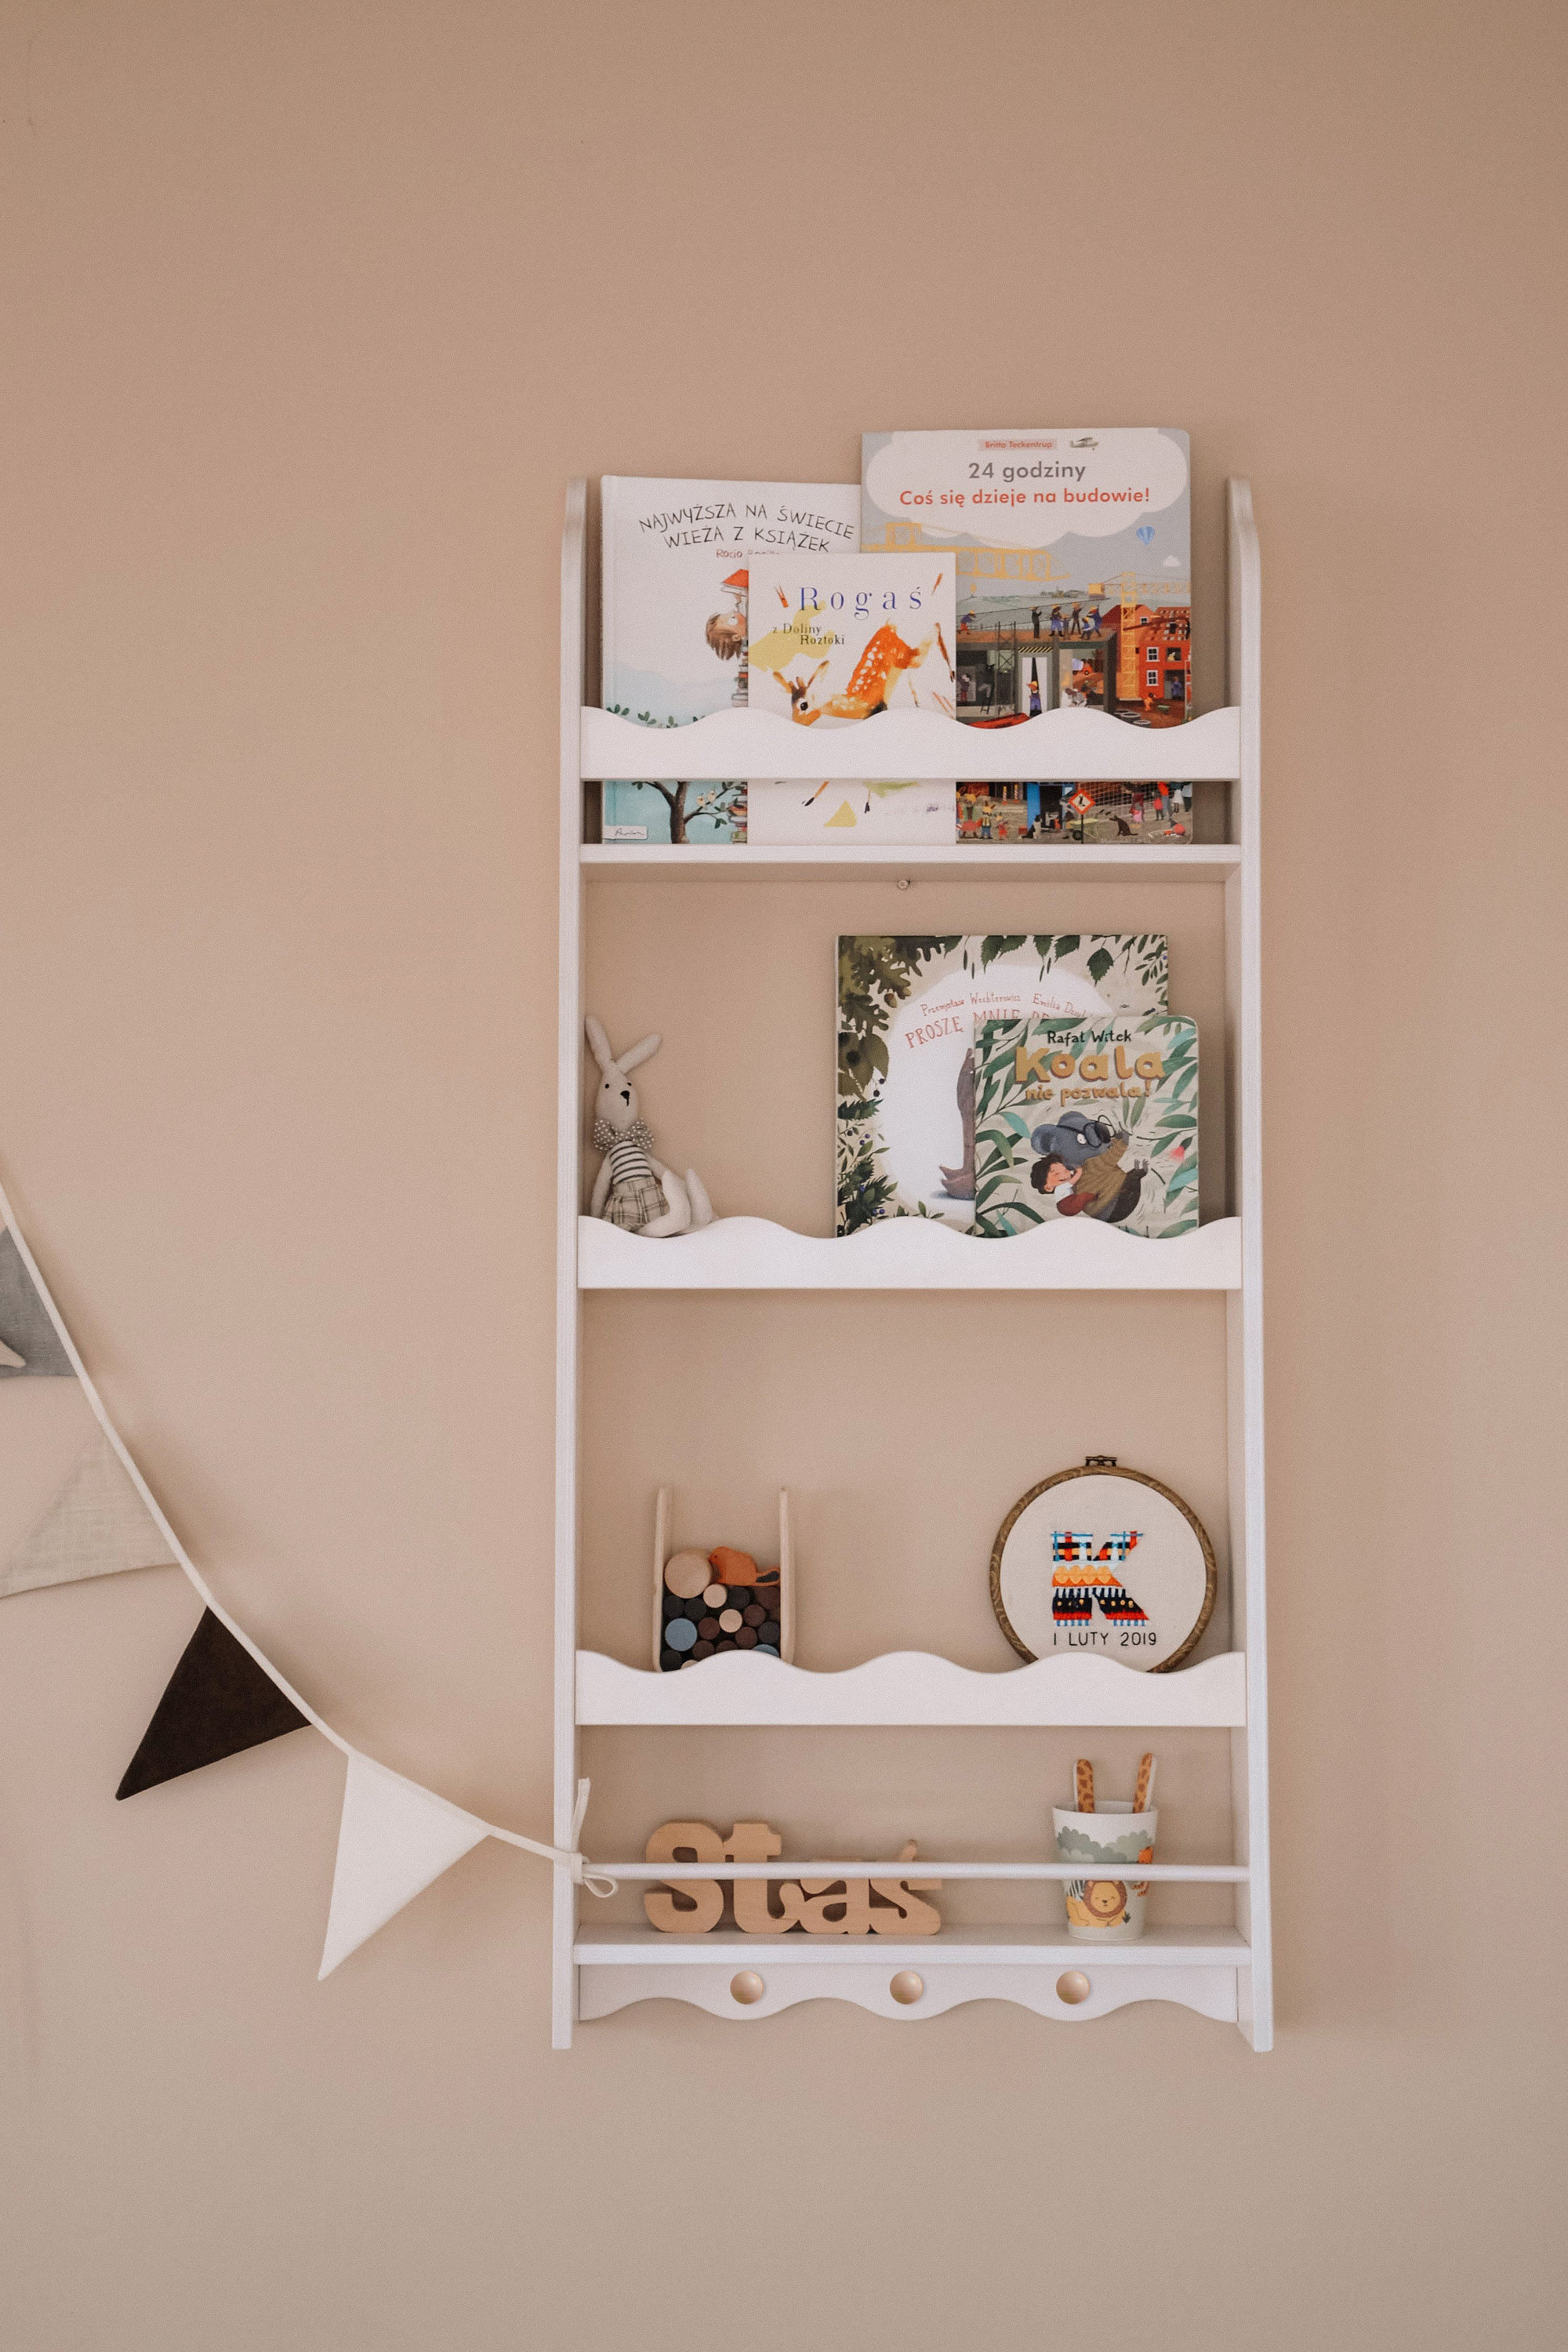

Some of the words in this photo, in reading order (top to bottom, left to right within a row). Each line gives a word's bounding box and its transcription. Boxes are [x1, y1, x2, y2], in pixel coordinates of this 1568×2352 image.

[968, 463, 994, 478] 24
[1002, 461, 1086, 483] godziny
[899, 490, 933, 505] Coś
[940, 490, 965, 507] się
[972, 489, 1026, 507] dzieje
[1033, 492, 1057, 503] na
[1064, 488, 1150, 503] budowie!
[638, 503, 736, 533] NAJWYŻSZA
[746, 504, 768, 519] NA
[777, 505, 855, 539] ŚWIECIE
[734, 526, 744, 541] Z
[754, 527, 829, 553] KSIĄŻEK
[800, 586, 922, 621] Rogaś
[783, 622, 822, 636] Doliny
[800, 633, 845, 645] Roztoki
[1033, 992, 1060, 1011] Emilia
[1091, 1029, 1131, 1043] Witek
[1015, 1044, 1166, 1084] Koala
[1025, 1084, 1054, 1100] nie
[1060, 1080, 1152, 1107] pozwala!
[1051, 1531, 1149, 1627] K
[1069, 1631, 1109, 1646] LUTY
[1120, 1631, 1157, 1646] 2019
